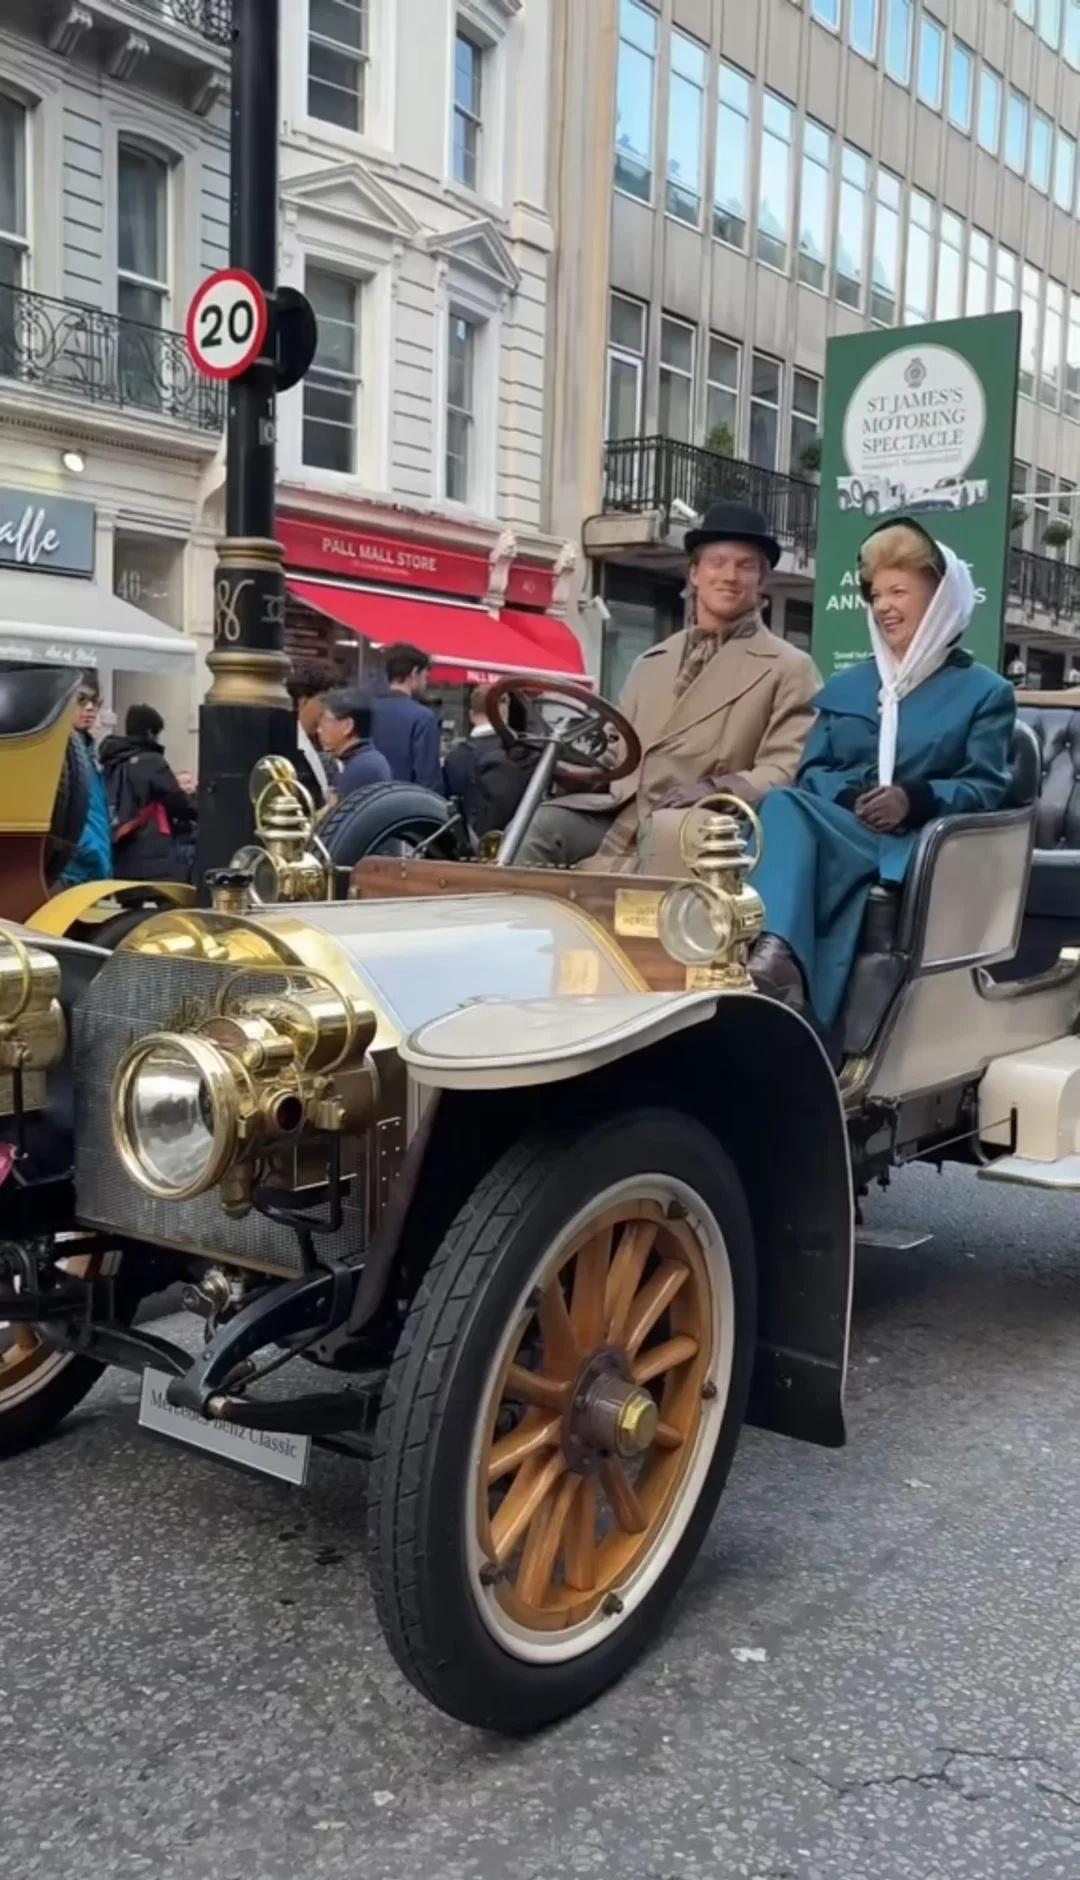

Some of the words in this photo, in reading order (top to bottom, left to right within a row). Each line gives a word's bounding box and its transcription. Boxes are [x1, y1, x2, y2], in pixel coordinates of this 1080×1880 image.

[200, 299, 254, 348] 20
[866, 395, 887, 413] ST
[888, 387, 964, 415] JAMES'S
[861, 408, 966, 435] MOTORING
[861, 428, 964, 454] SPECTACLE
[322, 537, 356, 558] PALL
[358, 544, 395, 565] MALL
[396, 551, 437, 572] STORE
[249, 1430, 298, 1458] Classic
